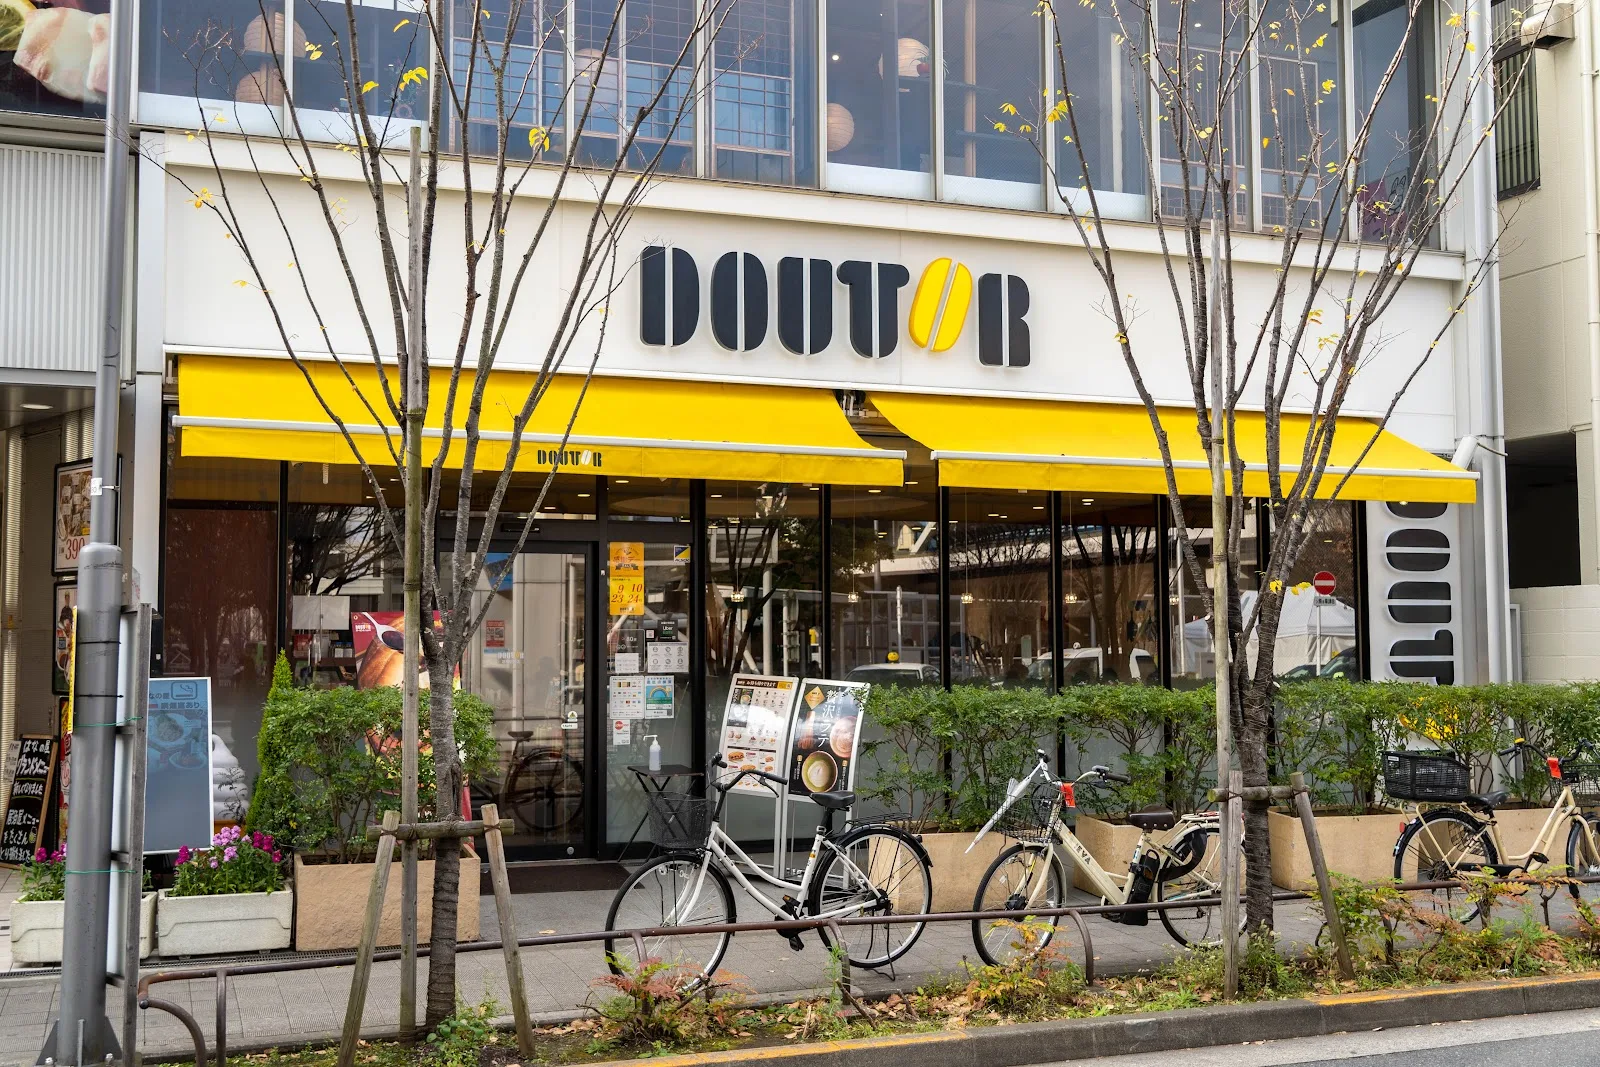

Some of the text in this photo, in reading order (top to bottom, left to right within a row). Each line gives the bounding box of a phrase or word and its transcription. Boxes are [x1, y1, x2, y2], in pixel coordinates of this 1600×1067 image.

[639, 245, 1031, 368] DOUTOR
[537, 449, 602, 467] DOUTOR
[617, 583, 643, 594] 9 10
[611, 593, 624, 604] 23
[22, 739, 51, 754] はなの屋
